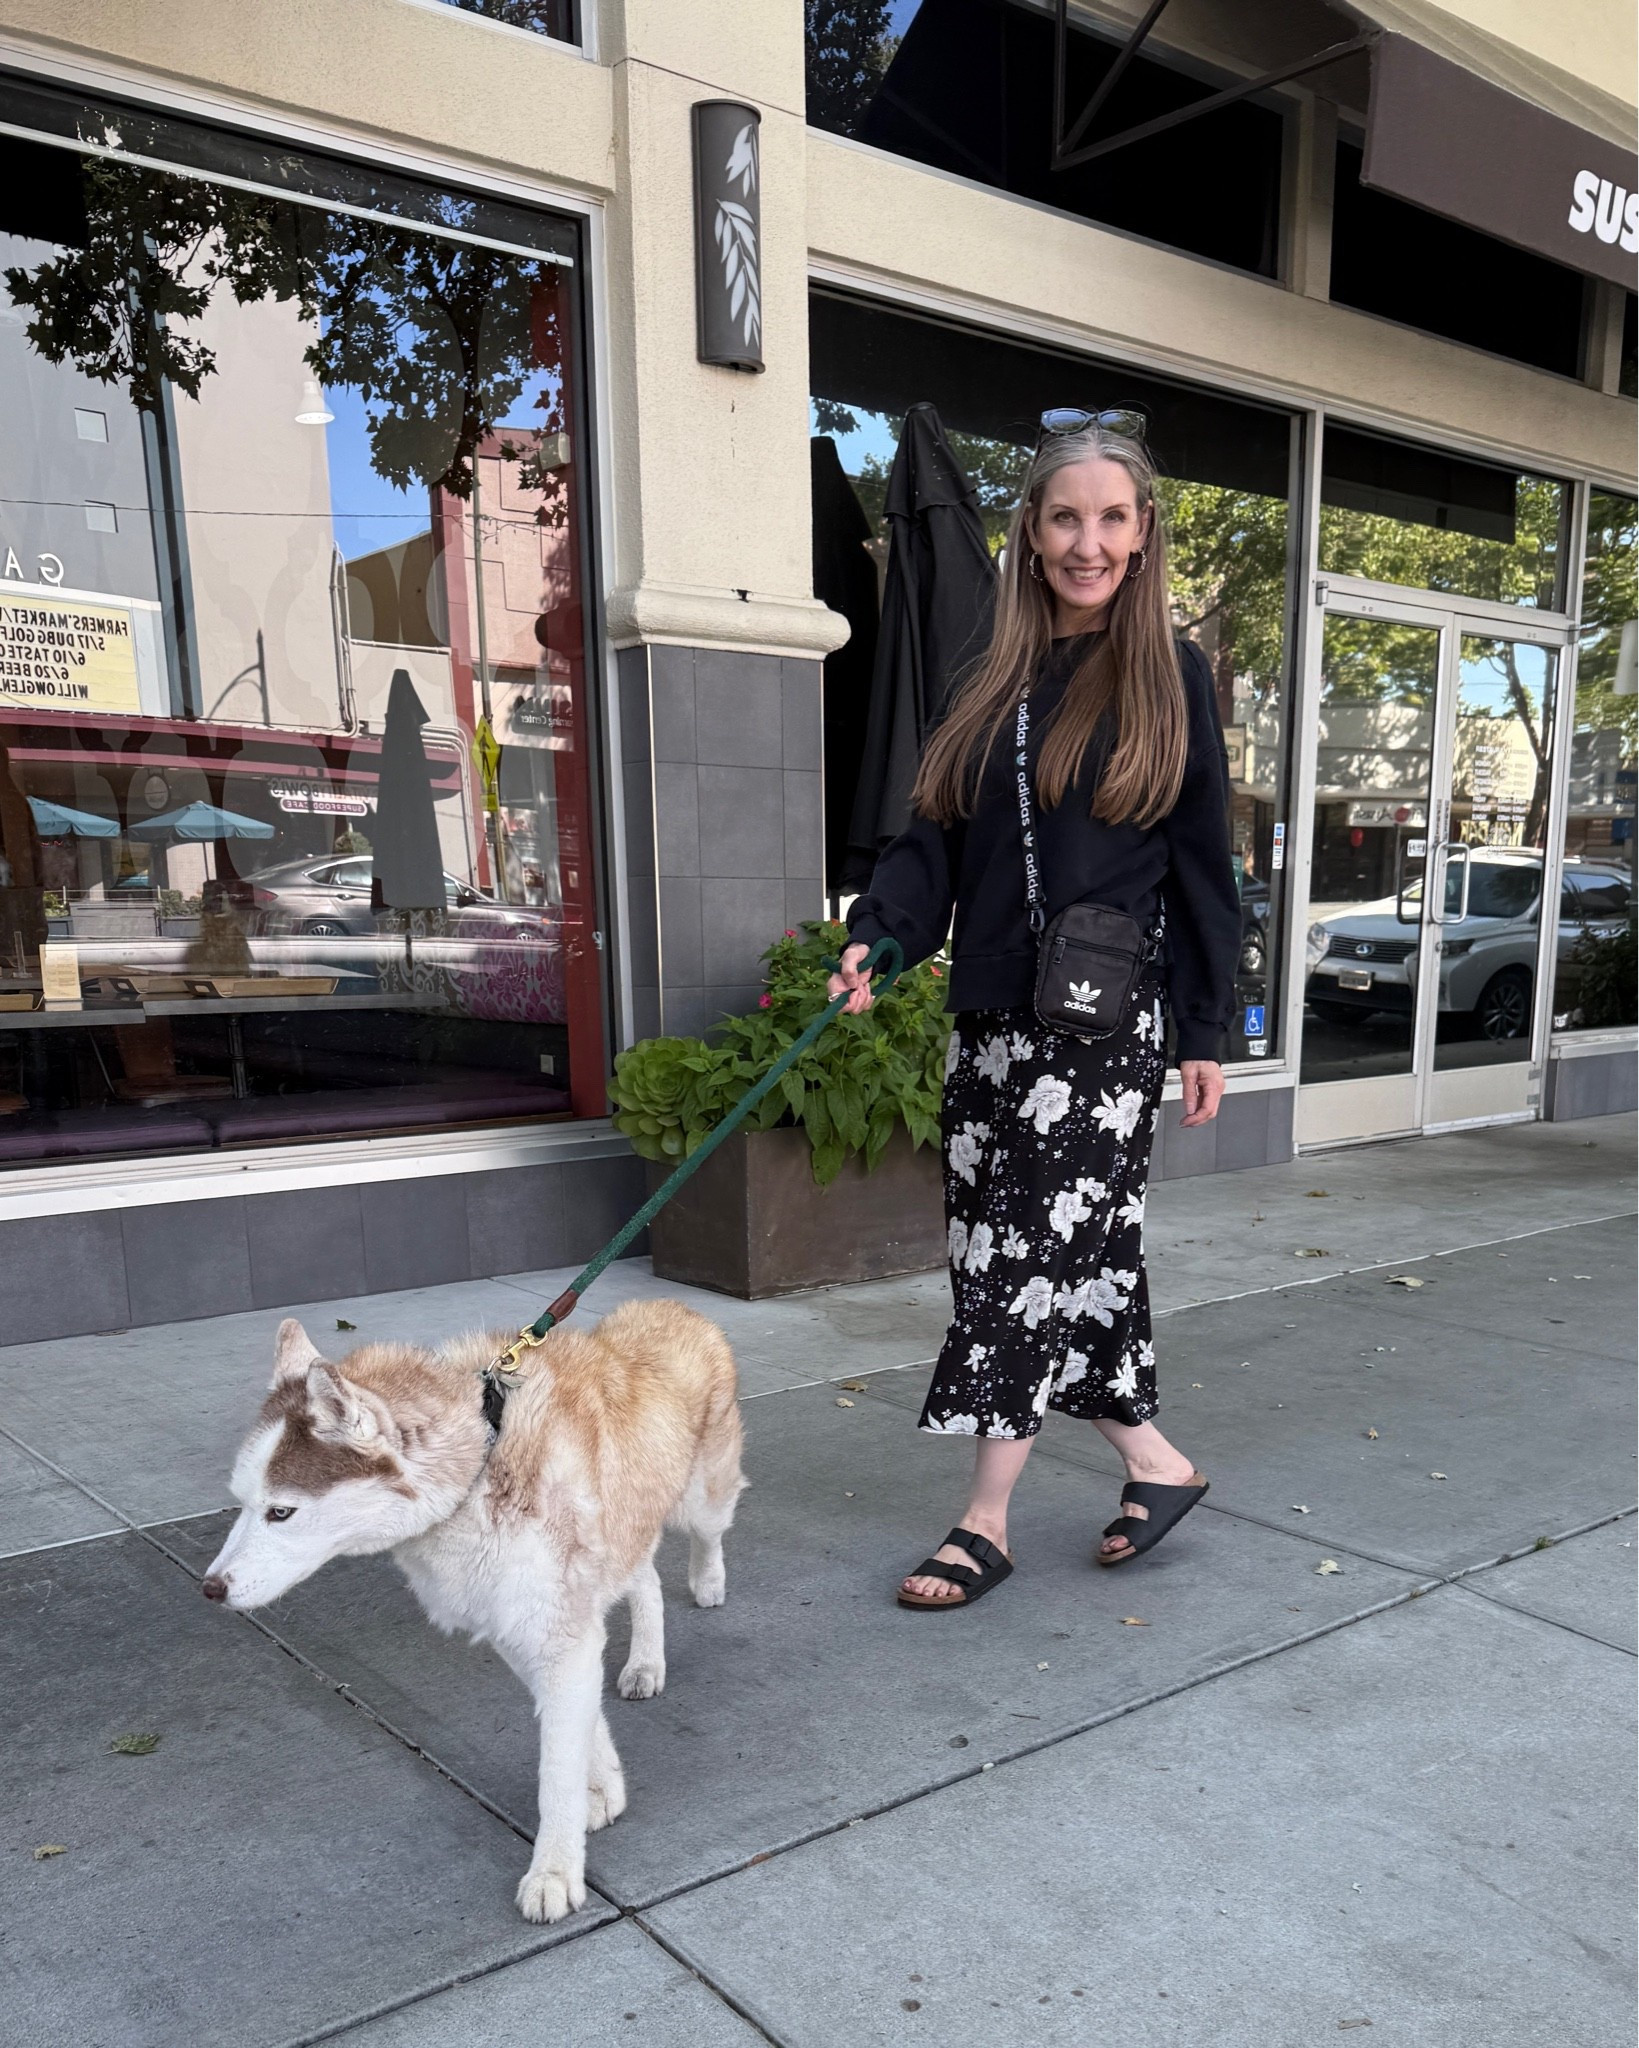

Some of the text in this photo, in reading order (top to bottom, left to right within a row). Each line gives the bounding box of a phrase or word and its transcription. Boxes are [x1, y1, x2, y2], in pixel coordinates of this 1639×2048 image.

[1016, 702, 1030, 748] adidas
[1016, 771, 1031, 827] adidas
[1063, 1000, 1097, 1015] adidas
